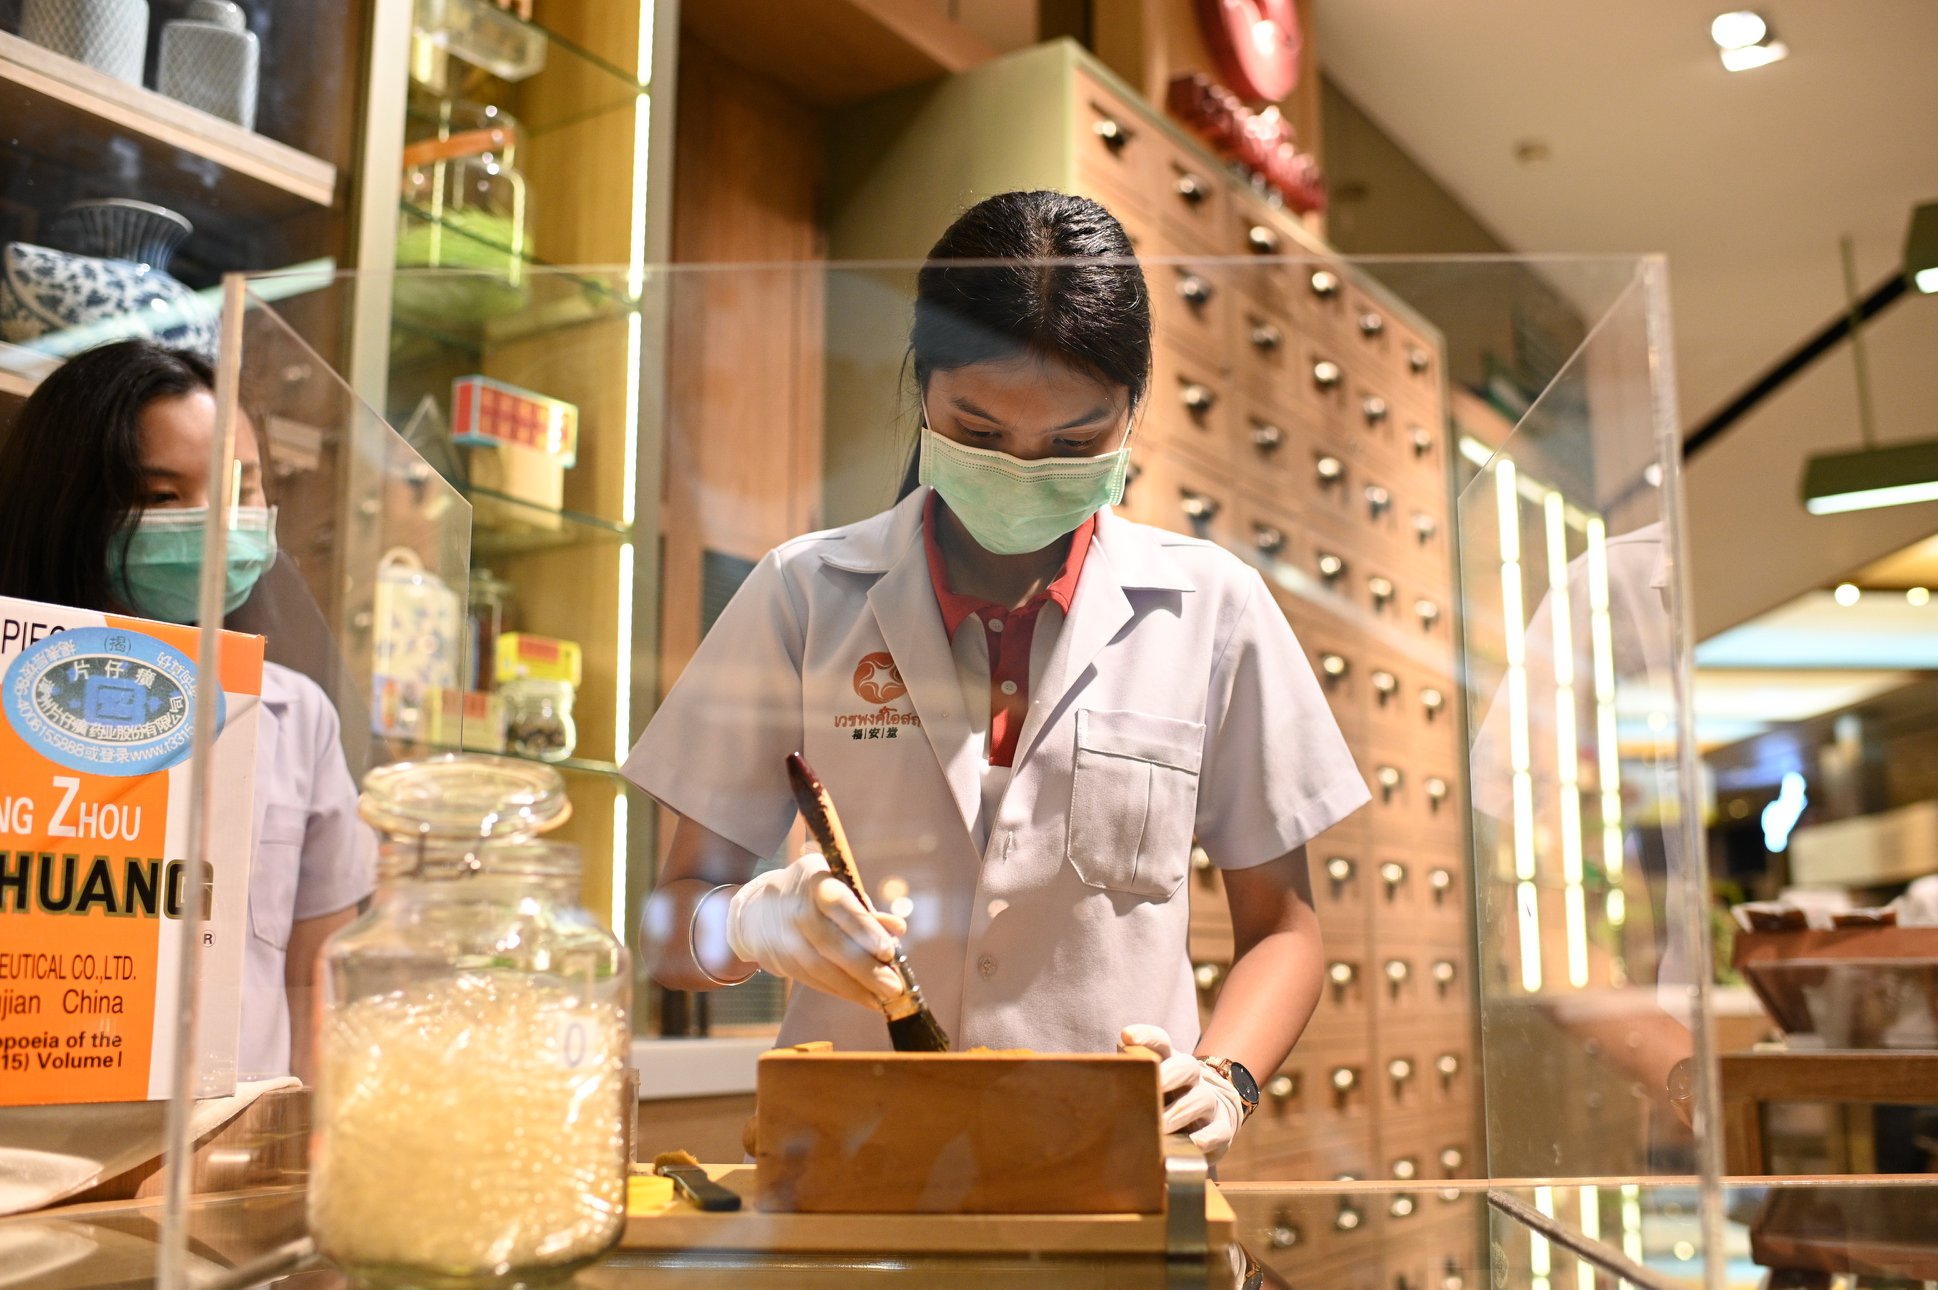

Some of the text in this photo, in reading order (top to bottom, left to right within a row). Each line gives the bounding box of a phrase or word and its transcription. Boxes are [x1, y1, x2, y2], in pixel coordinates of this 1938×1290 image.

[47, 775, 141, 842] ZHOU
[0, 988, 124, 1021] jian China
[66, 1030, 87, 1049] of
[91, 1031, 123, 1049] the
[37, 1051, 114, 1070] Volume
